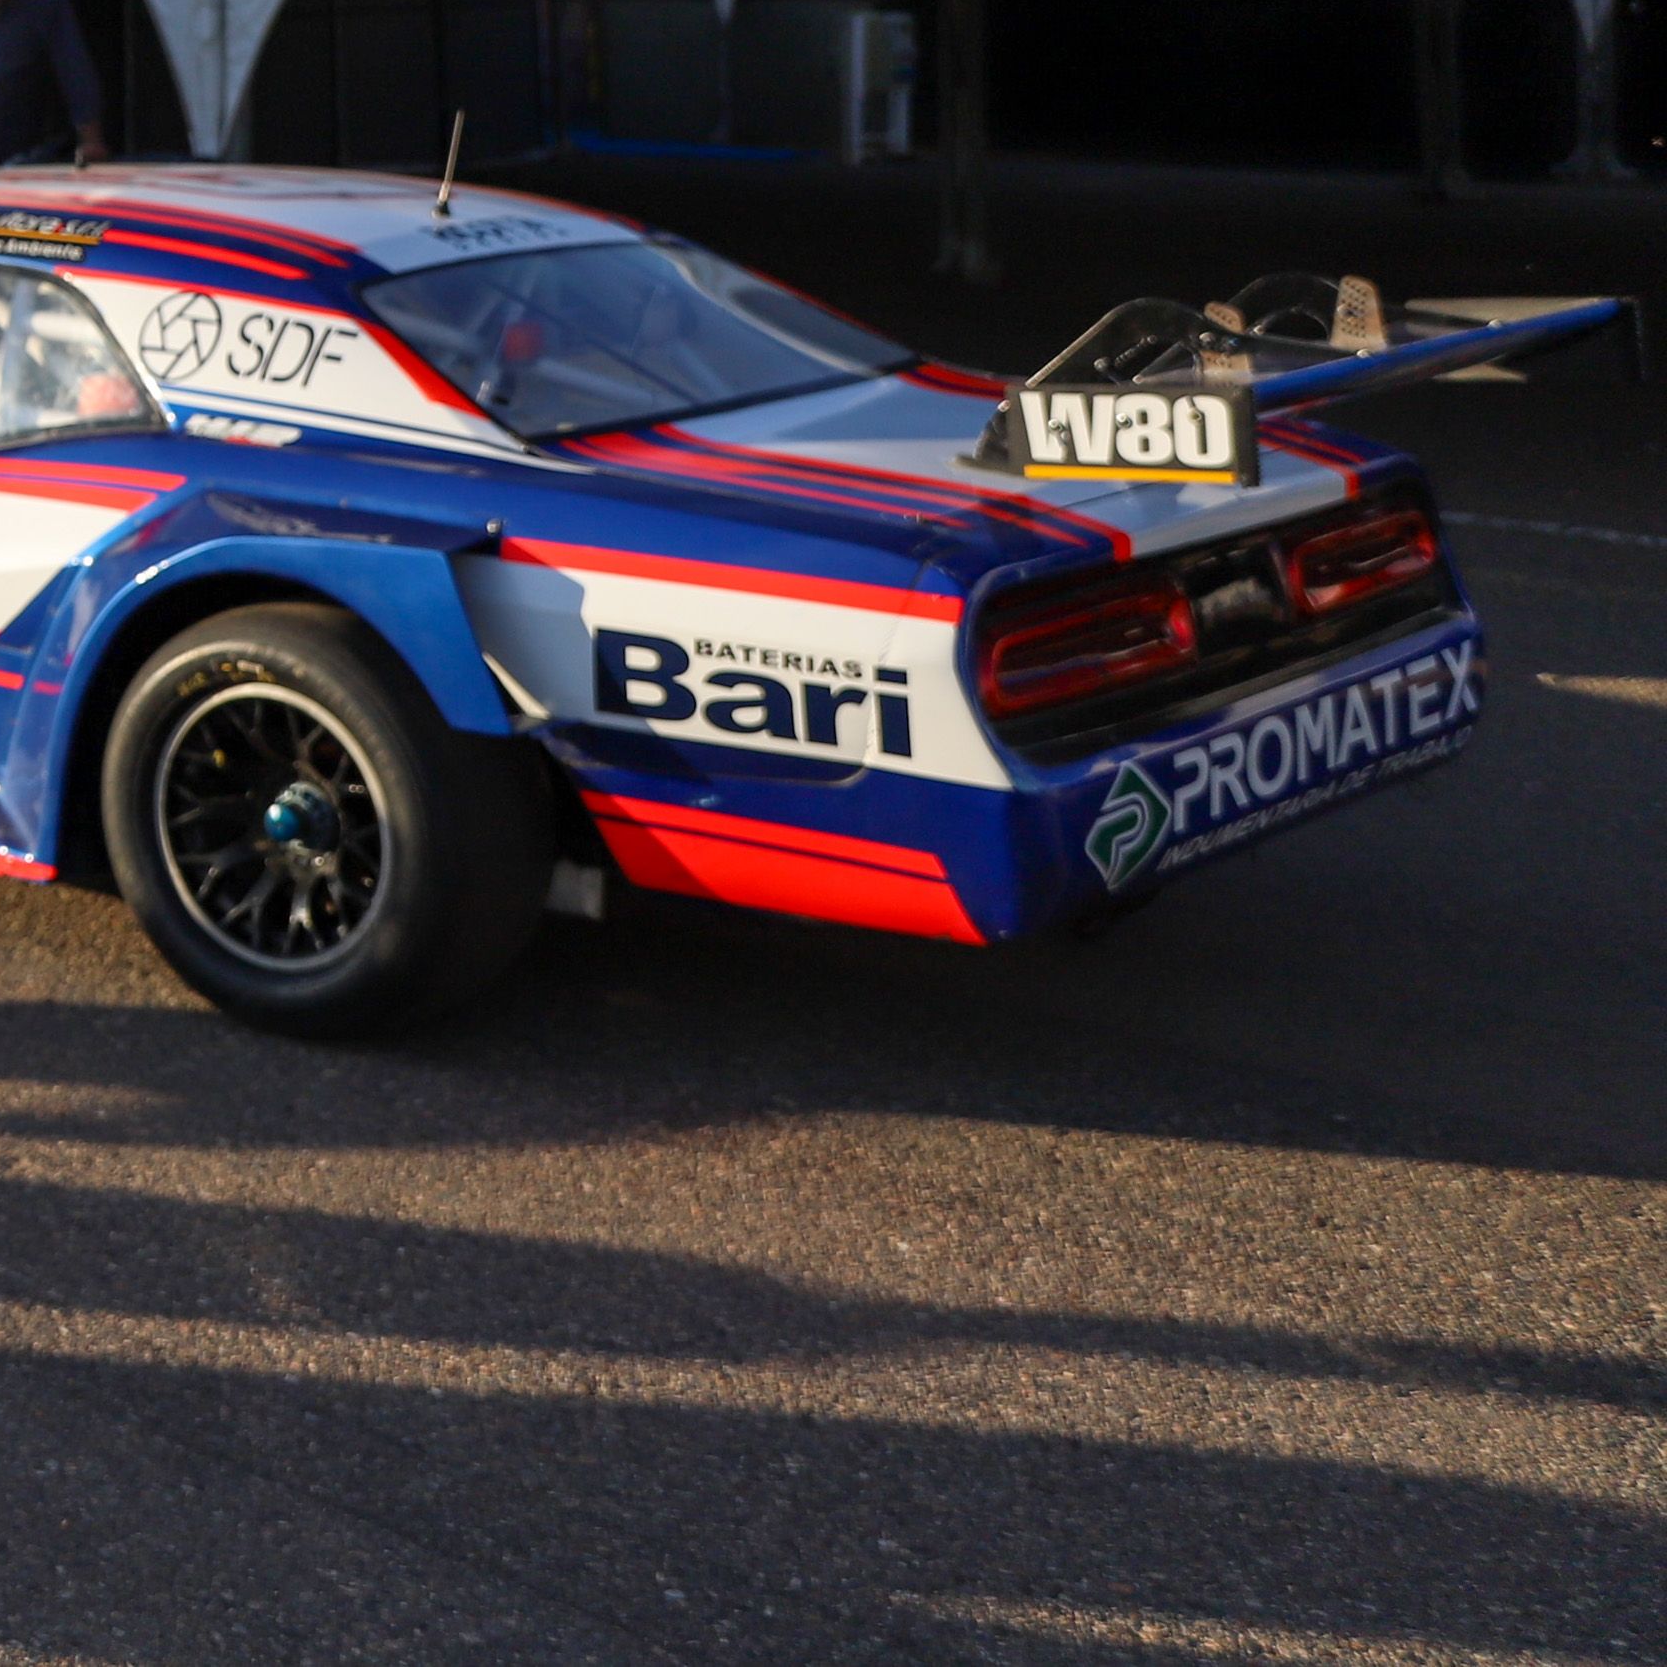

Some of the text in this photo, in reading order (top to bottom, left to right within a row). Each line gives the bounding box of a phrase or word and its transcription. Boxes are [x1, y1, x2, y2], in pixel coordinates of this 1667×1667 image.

[226, 313, 359, 387] SDF
[596, 627, 913, 759] Bari
[694, 637, 863, 680] BATERIAS
[1173, 638, 1479, 834] PROMATEX
